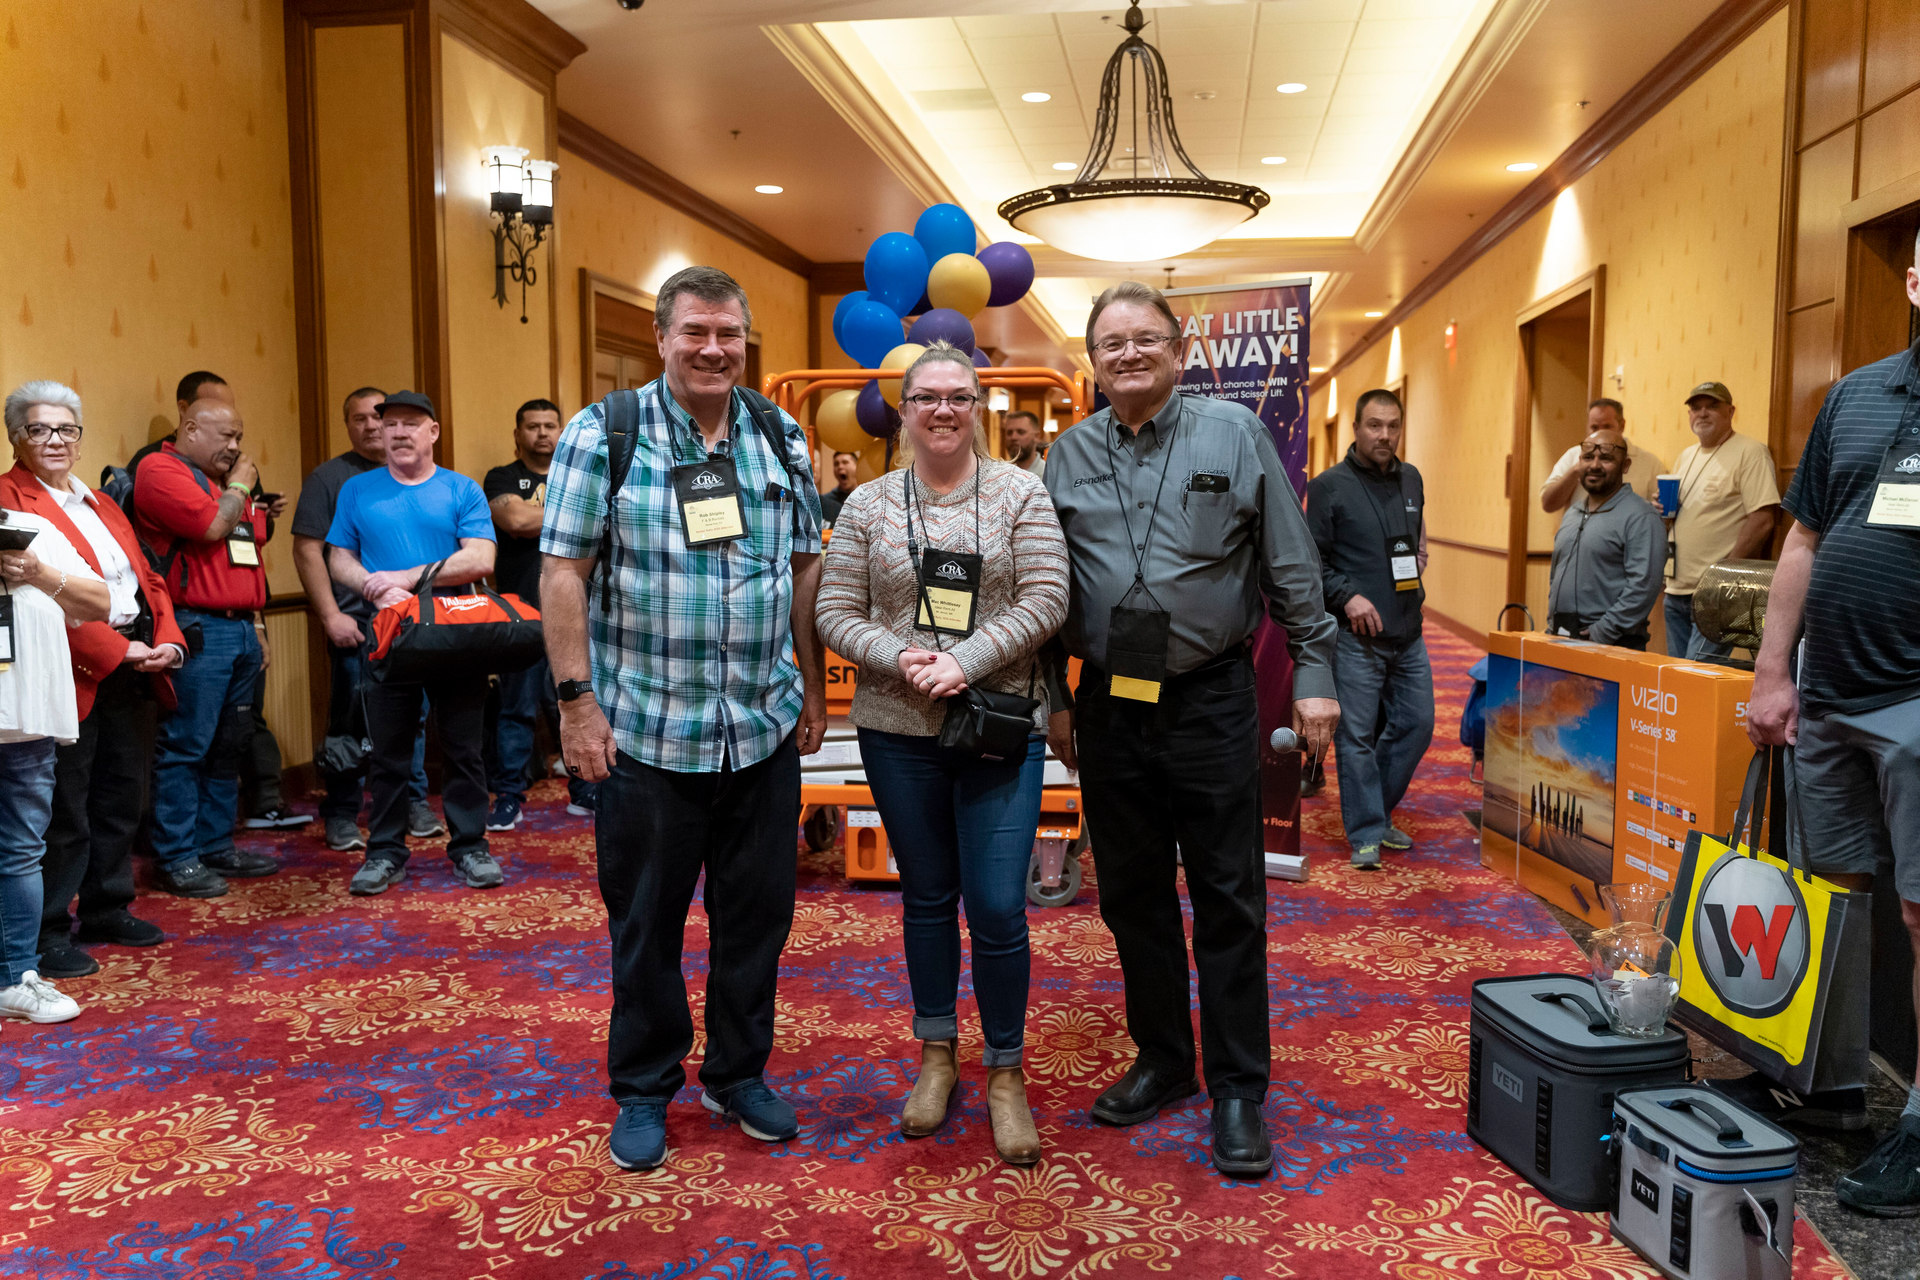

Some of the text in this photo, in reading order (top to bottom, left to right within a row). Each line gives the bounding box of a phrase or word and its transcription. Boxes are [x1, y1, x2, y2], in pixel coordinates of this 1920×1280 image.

[1175, 307, 1299, 338] AT LITTLE
[1178, 333, 1299, 371] AWAY!
[1202, 381, 1213, 390] for
[1223, 380, 1255, 389] chance
[1257, 379, 1266, 387] to
[1268, 376, 1288, 387] WIN
[1240, 389, 1269, 399] Scissor
[1270, 388, 1285, 398] Lift.
[697, 475, 719, 486] CRA
[942, 564, 962, 576] CRA
[1631, 684, 1678, 716] VIZIO
[1270, 817, 1293, 828] Floor
[1495, 1067, 1520, 1096] YETI
[1635, 1179, 1655, 1202] YETI
